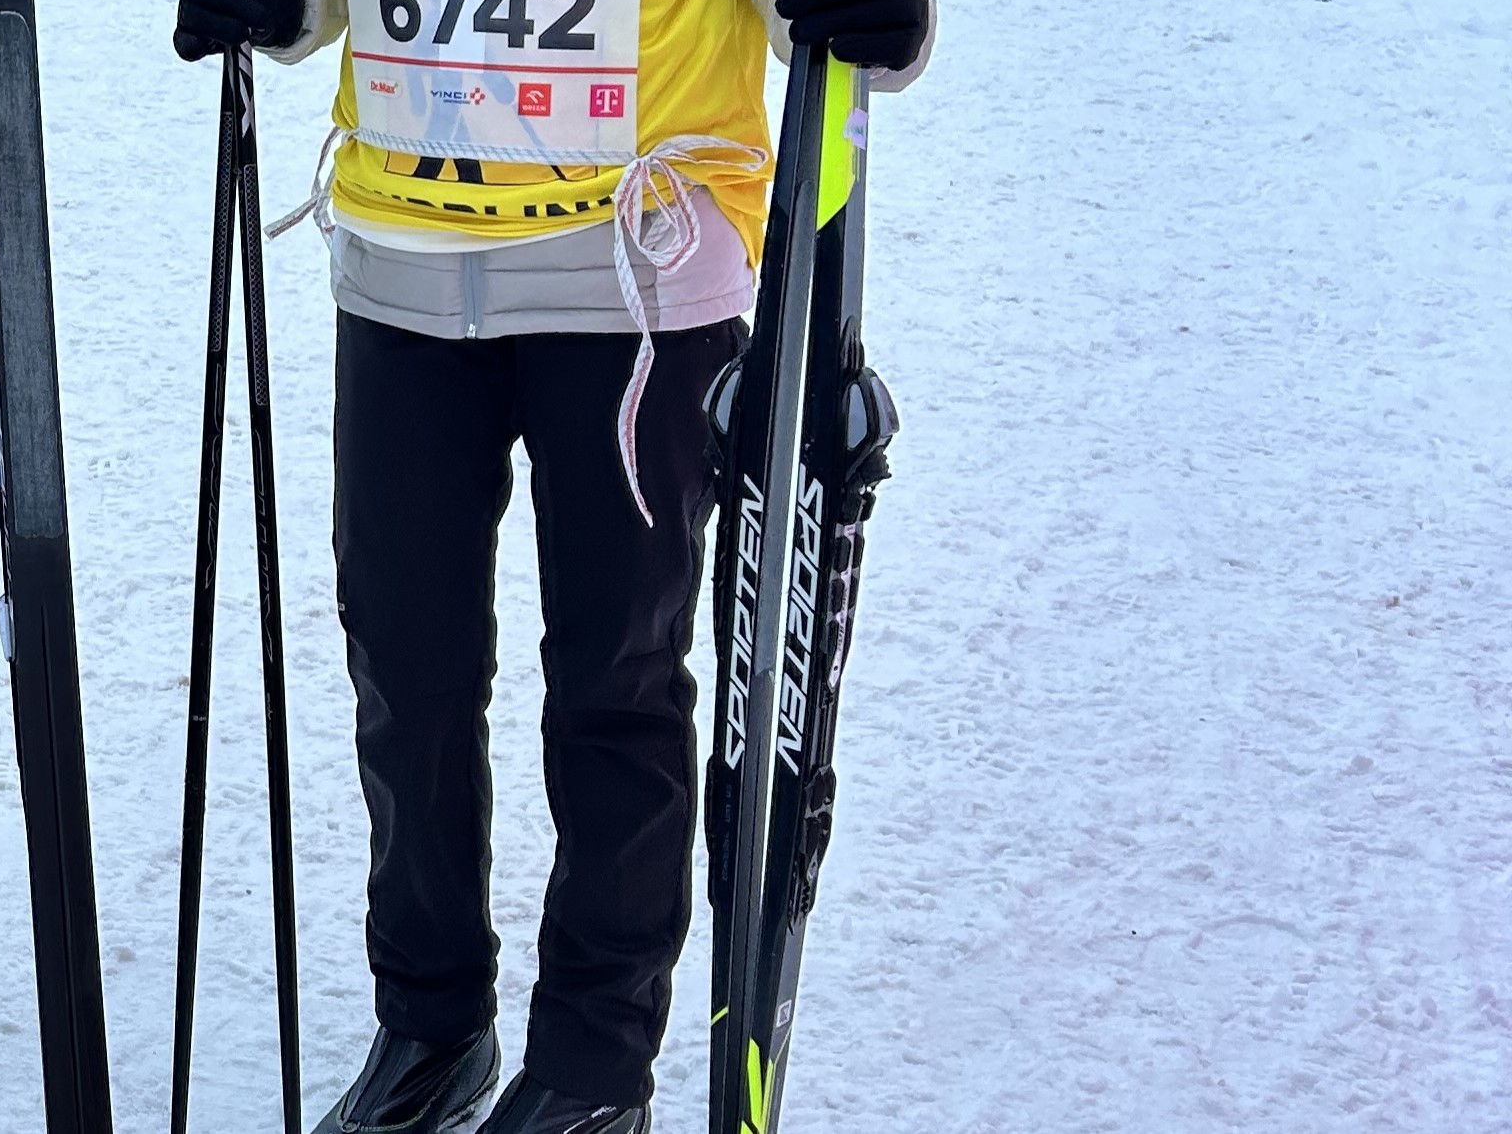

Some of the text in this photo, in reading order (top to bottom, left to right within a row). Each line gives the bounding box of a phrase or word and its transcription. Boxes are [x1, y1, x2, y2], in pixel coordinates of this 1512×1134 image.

[430, 90, 467, 100] VINCI
[725, 473, 764, 770] SPORTEN
[777, 463, 823, 776] SPORTEN
